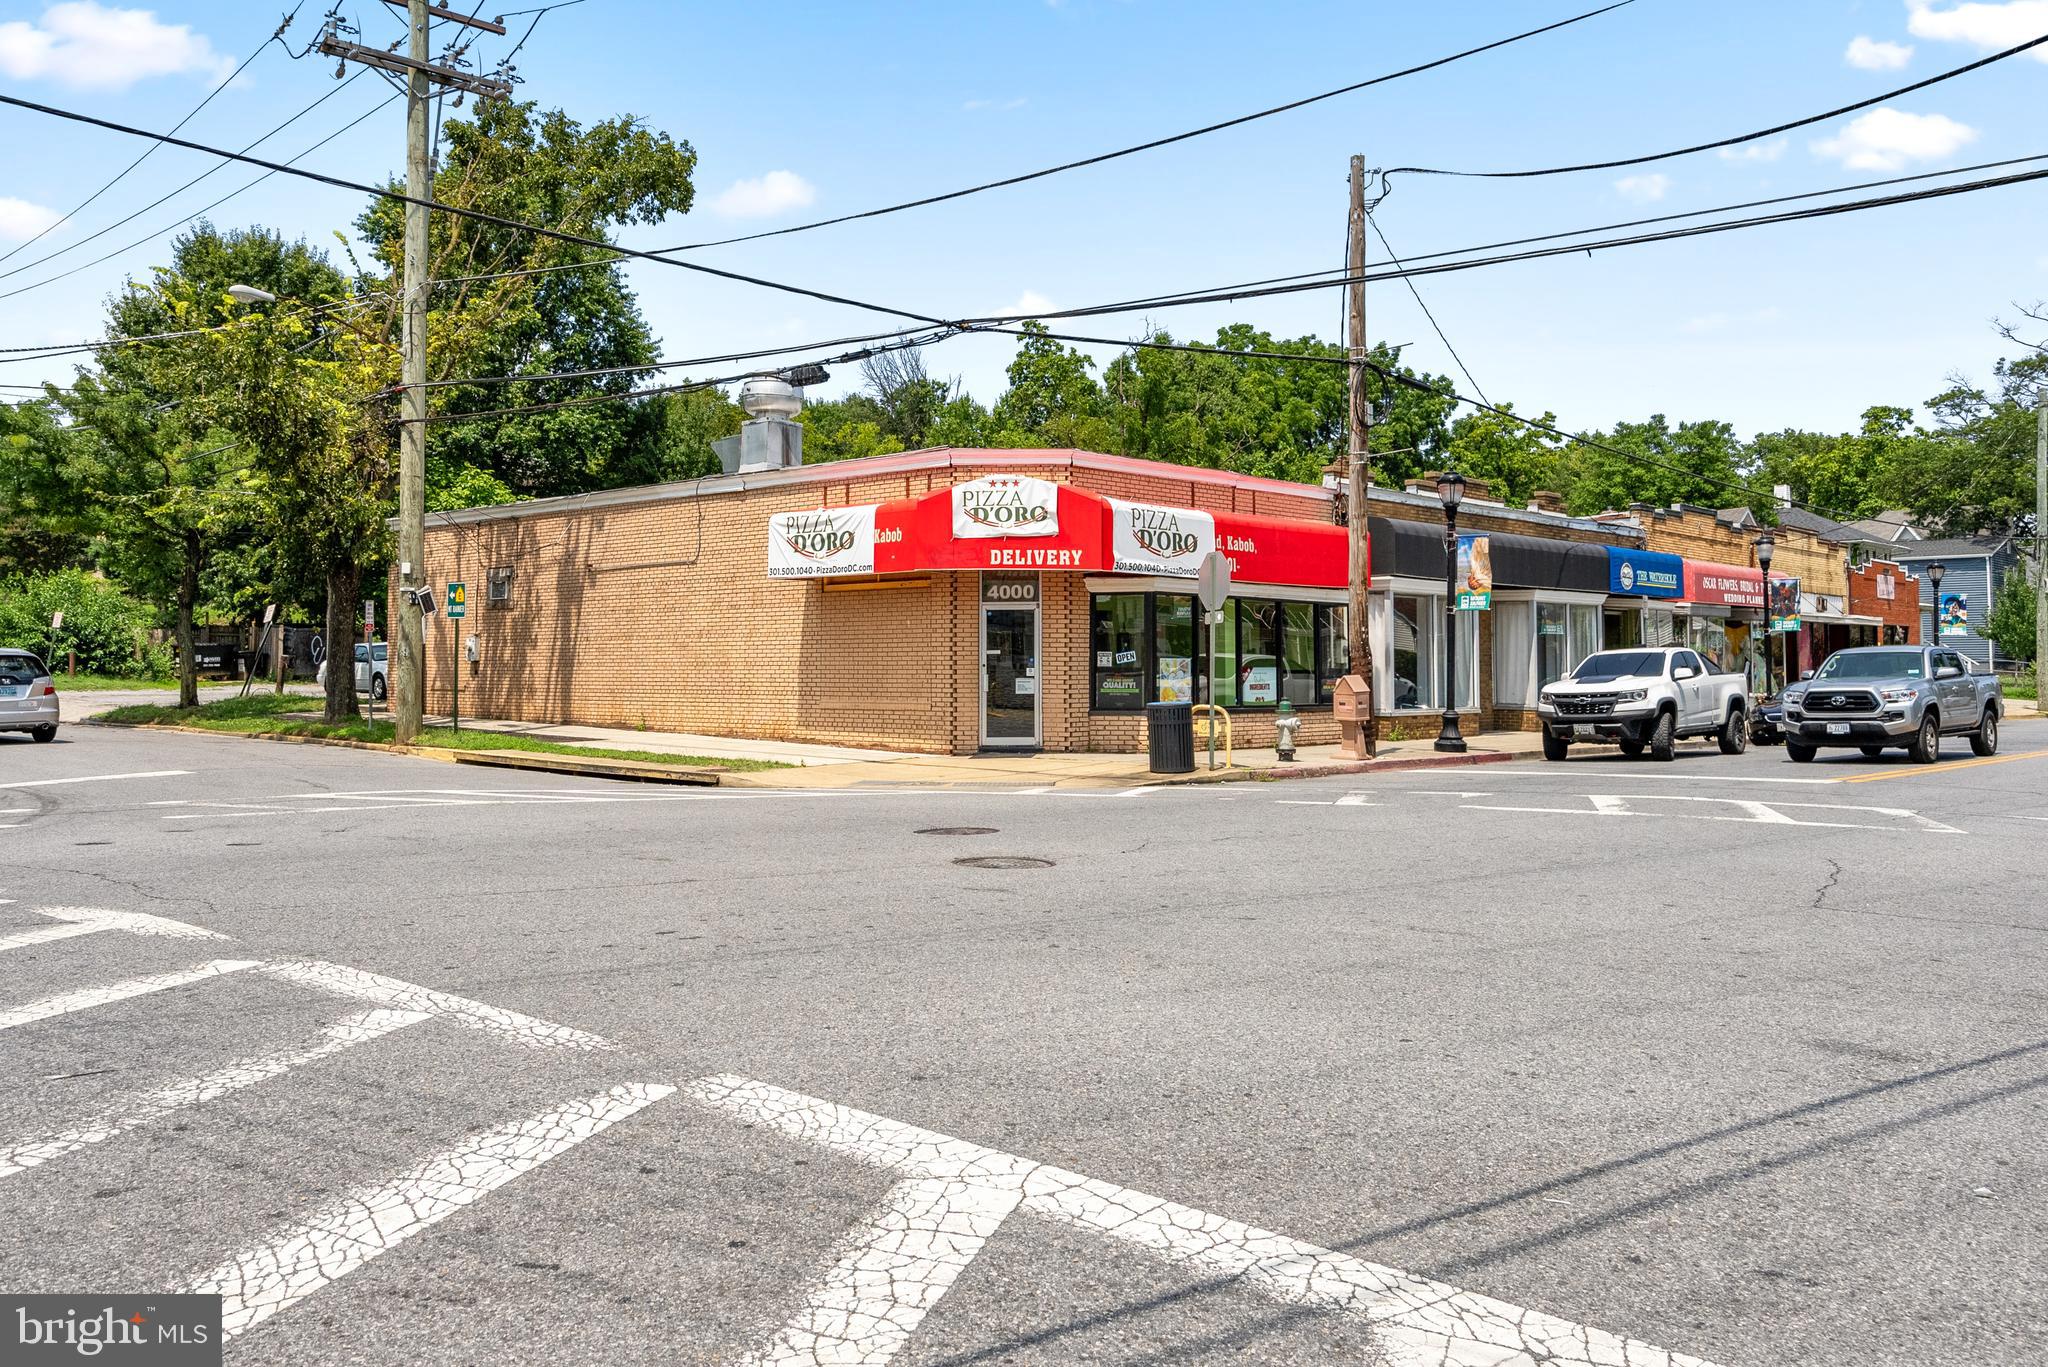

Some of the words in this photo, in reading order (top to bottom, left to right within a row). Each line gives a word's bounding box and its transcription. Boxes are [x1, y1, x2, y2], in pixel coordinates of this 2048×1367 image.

[962, 490, 1023, 507] PIZZA
[969, 505, 1048, 523] D'ORO
[1131, 507, 1179, 531] PIZZA
[786, 514, 835, 535] PIZZA
[790, 530, 855, 553] D'ORO
[874, 527, 902, 543] Kabob
[1137, 529, 1198, 553] D'ORO
[1227, 535, 1258, 554] Kabob,
[990, 549, 1083, 566] DELIVERY
[987, 584, 1035, 599] 4000
[1702, 576, 1717, 590] OSCAR
[1740, 580, 1755, 593] BRIDAL
[1755, 582, 1760, 593] &
[1723, 593, 1746, 604] WEDDING
[1746, 594, 1765, 605] PLANNE
[1116, 652, 1136, 663] OPEN
[1102, 681, 1137, 689] QUALITY!
